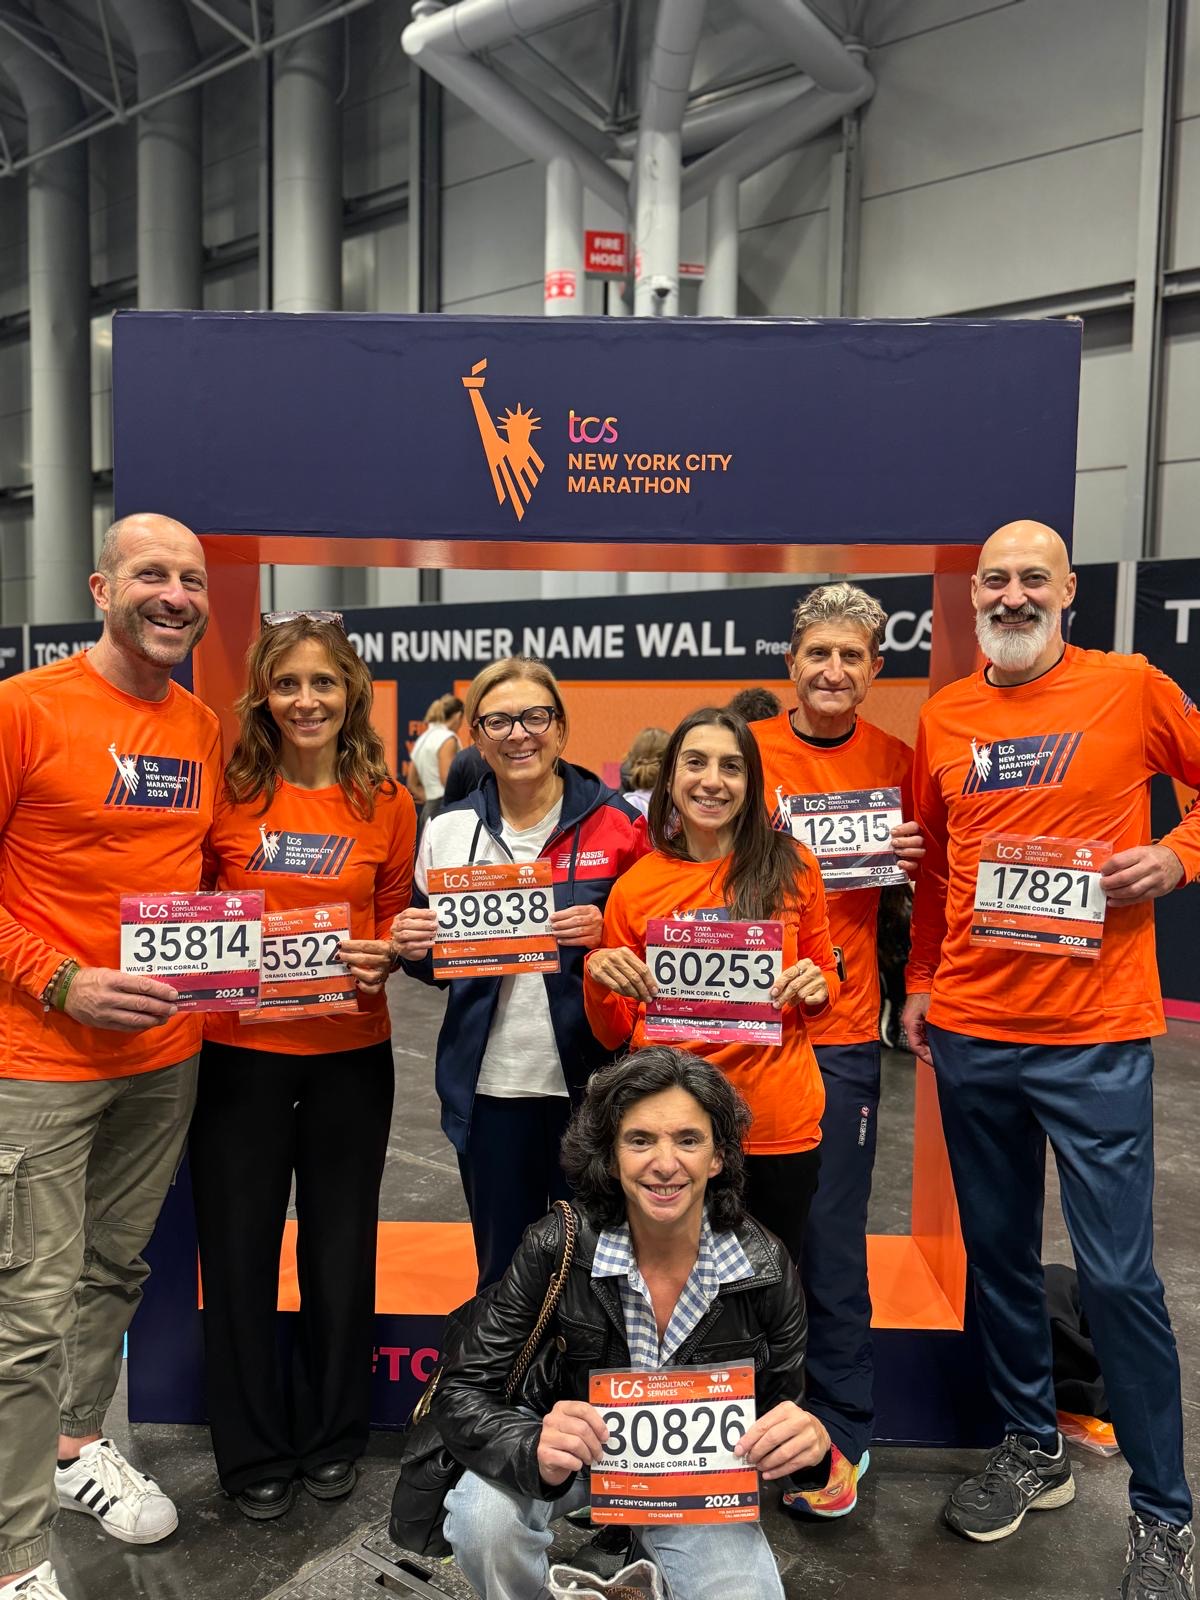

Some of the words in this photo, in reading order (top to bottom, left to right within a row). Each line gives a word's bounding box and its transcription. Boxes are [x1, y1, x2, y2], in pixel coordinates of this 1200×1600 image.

[594, 237, 621, 250] FIRE
[590, 253, 625, 266] HOSE
[569, 410, 618, 444] tcs
[568, 453, 618, 470] NEW
[624, 454, 681, 471] YORK
[686, 454, 733, 471] CITY
[568, 476, 691, 494] MARATHON
[1164, 599, 1200, 643] T
[391, 628, 514, 662] RUNNER
[523, 627, 625, 659] NAME
[635, 620, 746, 658] WALL
[755, 639, 792, 655] Pres
[34, 642, 70, 666] TCS
[998, 744, 1015, 755] tcs
[143, 760, 159, 772] tcs
[999, 760, 1040, 770] MARATHON
[999, 770, 1023, 781] 2024
[146, 781, 182, 789] MARATHON
[147, 790, 168, 798] 2024
[803, 798, 826, 811] tcs
[804, 813, 890, 846] 12315
[287, 836, 302, 846] tcs
[996, 842, 1023, 859] tcs
[285, 858, 306, 866] 2024
[1072, 859, 1093, 867] TATA
[870, 866, 894, 875] 2024
[443, 872, 469, 888] tcs
[993, 866, 1090, 908] 17821
[139, 901, 168, 918] tcs
[437, 891, 549, 929] 39838
[702, 912, 719, 922] tcs
[664, 924, 691, 943] tcs
[694, 931, 734, 939] CONSULTANCY
[133, 924, 249, 963] 35814
[1059, 936, 1087, 947] 2024
[262, 934, 343, 971] 5522
[518, 952, 545, 963] 2024
[146, 964, 153, 972] 3
[200, 962, 208, 970] D
[311, 968, 318, 976] D
[654, 950, 775, 989] 60253
[215, 988, 244, 998] 2024
[318, 992, 344, 1003] 2024
[670, 987, 677, 995] 5
[722, 990, 730, 998] C
[738, 1020, 767, 1030] 2024
[372, 1346, 440, 1382] TC
[610, 1377, 644, 1399] tcs
[647, 1380, 694, 1388] CONSULTANCY
[707, 1384, 733, 1393] TATA
[601, 1404, 746, 1457] 30826
[620, 1459, 628, 1468] 3
[633, 1461, 665, 1469] ORANGE
[699, 1457, 707, 1467] B
[609, 1499, 677, 1507] #TCSNYCMarathon
[704, 1494, 740, 1508] 2024
